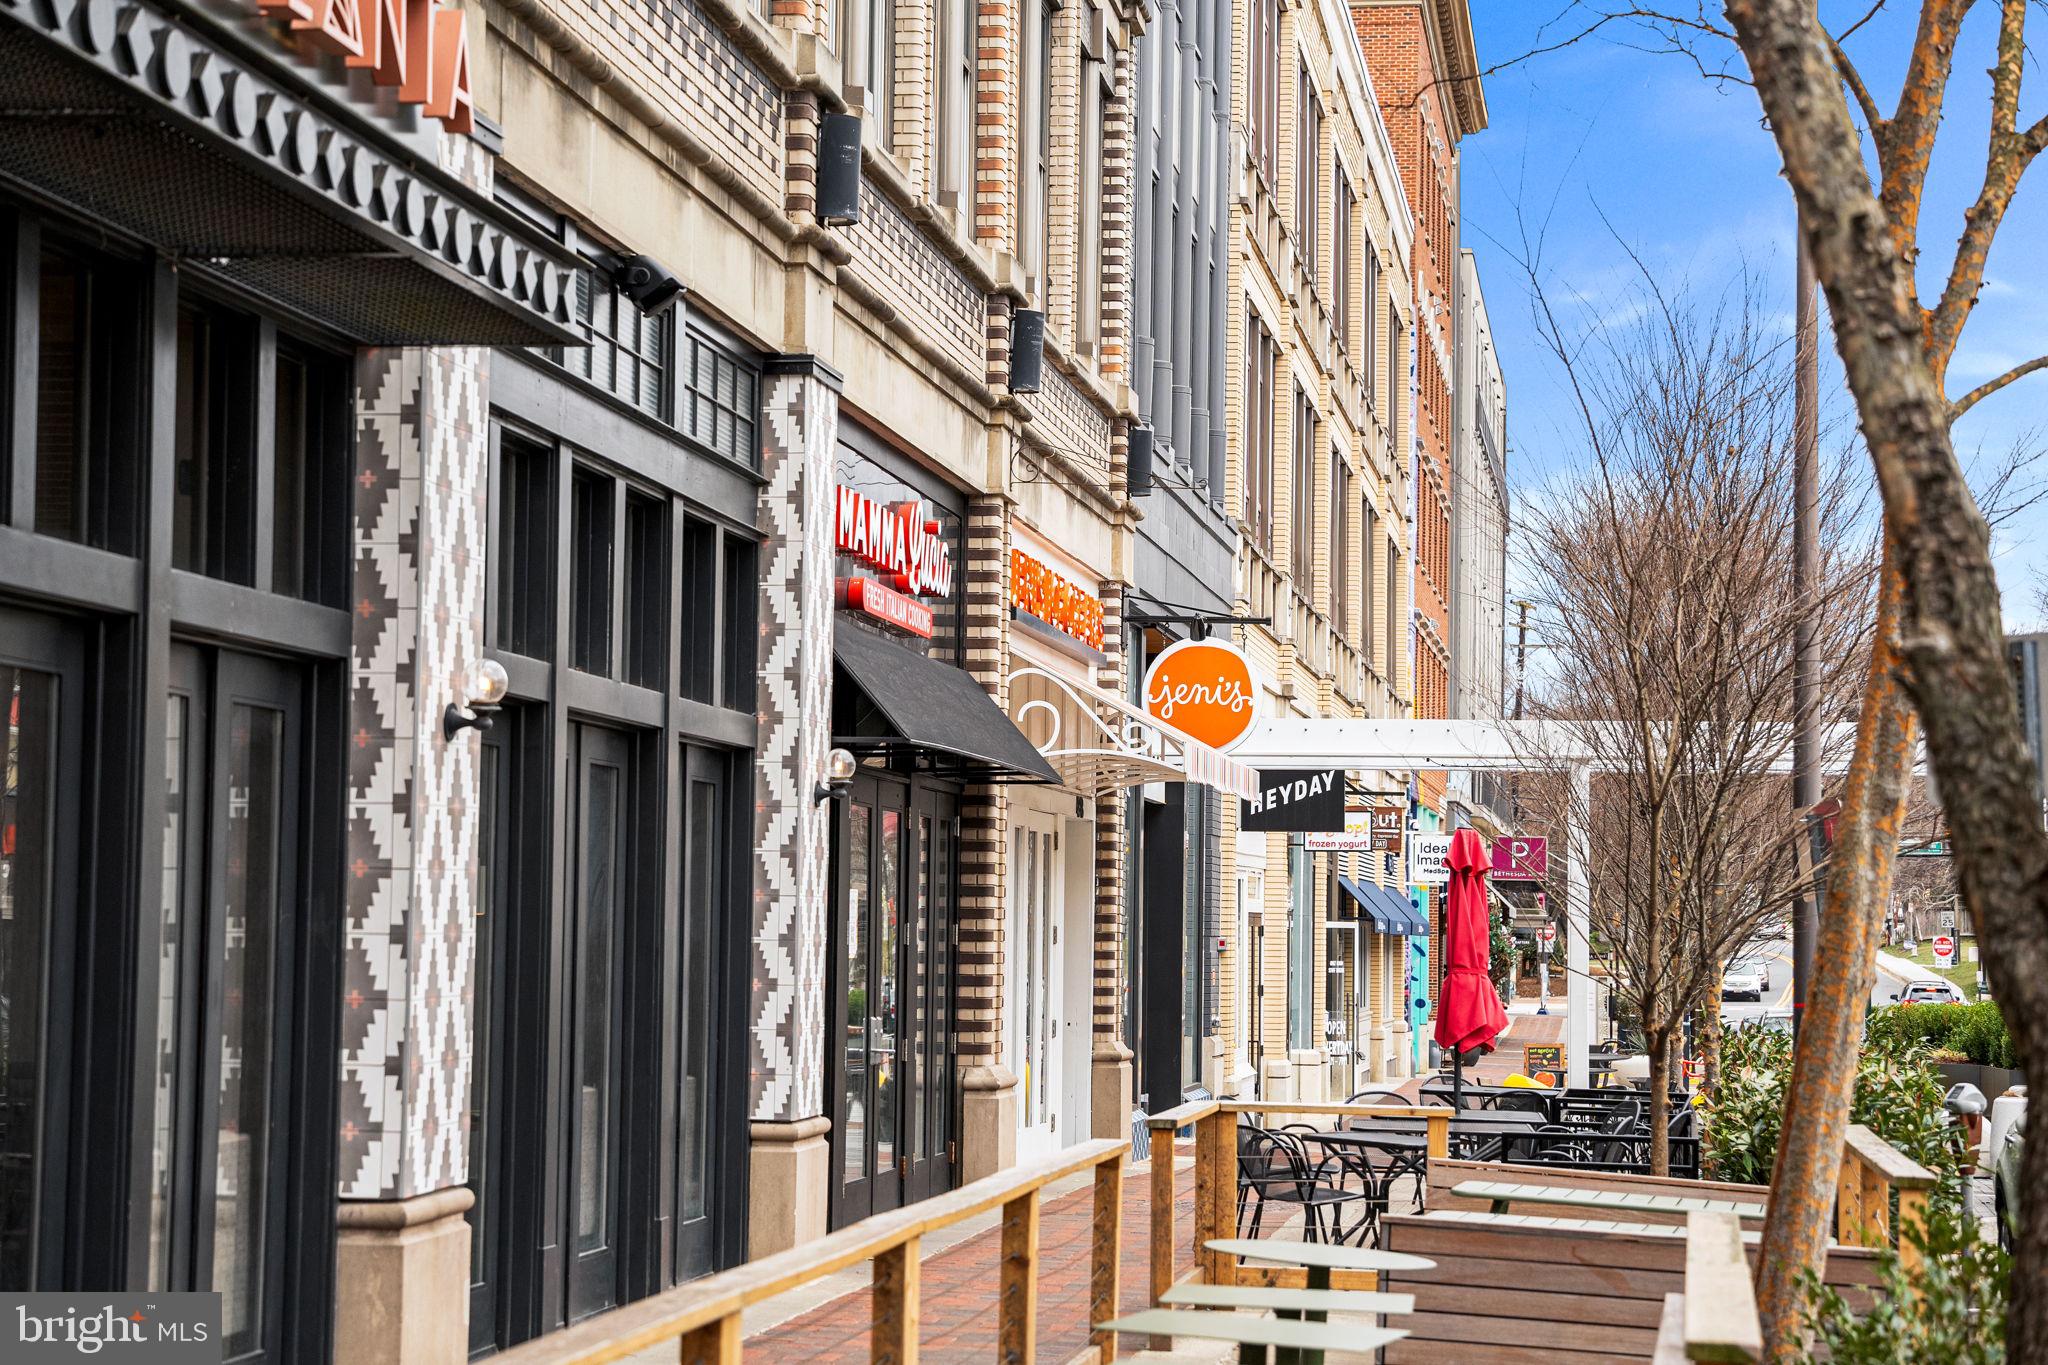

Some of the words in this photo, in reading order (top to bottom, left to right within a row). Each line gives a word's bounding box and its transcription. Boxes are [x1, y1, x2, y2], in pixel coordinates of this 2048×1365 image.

[839, 484, 907, 576] MAMMA
[866, 583, 885, 612] FRESH
[885, 592, 907, 622] ITALIAN
[908, 603, 931, 634] COOKING
[1148, 674, 1256, 719] jeni's
[1250, 770, 1336, 815] HEYDAY
[1308, 840, 1337, 848] frozen
[1338, 840, 1367, 849] yogurt
[1327, 1020, 1346, 1035] OPEN
